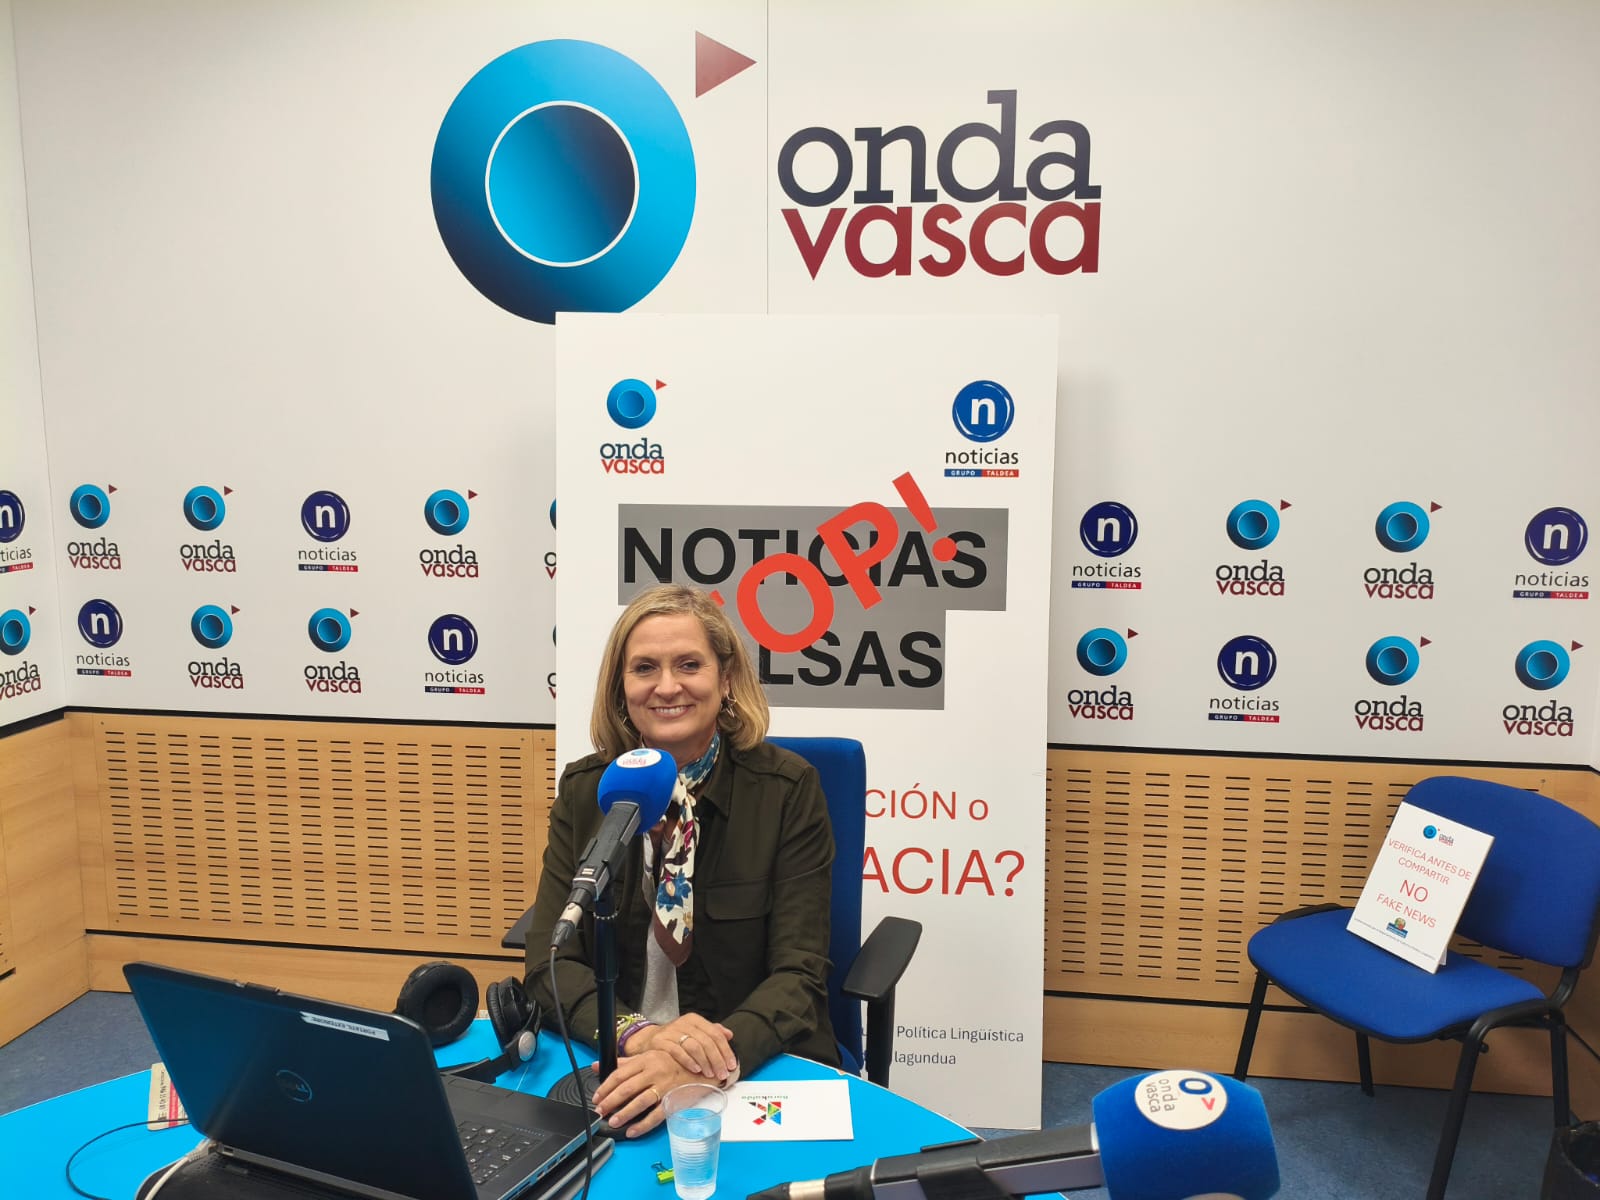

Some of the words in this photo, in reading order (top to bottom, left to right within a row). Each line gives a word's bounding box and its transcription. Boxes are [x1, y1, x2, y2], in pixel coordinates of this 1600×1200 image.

[777, 89, 1102, 207] onda
[781, 201, 1102, 281] vasca
[970, 397, 996, 425] n
[600, 438, 664, 460] onda
[945, 448, 1019, 466] noticias
[601, 458, 665, 474] vasca
[950, 469, 976, 477] GRUPO
[986, 470, 1015, 478] TALDEA
[314, 505, 336, 528] n
[1096, 517, 1121, 542] n
[1542, 523, 1569, 550] n
[0, 546, 32, 562] ticias
[67, 537, 120, 557] onda
[180, 540, 235, 560] onda
[298, 547, 357, 562] noticias
[419, 544, 478, 565] onda
[69, 556, 122, 570] vasca
[181, 558, 237, 572] vasca
[420, 563, 479, 578] vasca
[709, 471, 958, 654] OP!
[1072, 562, 1142, 578] noticias
[1216, 560, 1285, 581] onda
[1363, 562, 1434, 585] onda
[1514, 571, 1589, 588] noticias
[1216, 580, 1285, 596] vasca
[1364, 583, 1434, 600] vasca
[90, 613, 110, 635] n
[442, 628, 463, 651] n
[76, 653, 130, 667] noticias
[188, 657, 243, 677] onda
[1234, 651, 1259, 676] n
[304, 661, 361, 681] onda
[424, 669, 484, 684] noticias
[189, 675, 244, 689] vasca
[305, 679, 361, 693] vasca
[1067, 685, 1133, 707] onda
[1209, 696, 1279, 712] noticias
[1354, 695, 1424, 717] onda
[1068, 704, 1134, 720] vasca
[1502, 700, 1574, 722] onda
[1355, 715, 1424, 731] vasca
[1502, 720, 1574, 736] vasca
[968, 799, 989, 821] o
[1388, 838, 1427, 861] VERIFICA
[1427, 855, 1457, 875] ANTES
[1457, 867, 1473, 881] DE
[1398, 857, 1451, 885] COMPARTIR
[1400, 879, 1429, 903] NO
[1376, 893, 1404, 913] FAKE
[1403, 906, 1437, 929] NEWS
[896, 1025, 947, 1040] Política
[894, 1051, 957, 1067] lagundua
[1145, 1082, 1161, 1113] vasca
[1158, 1079, 1178, 1112] onda
